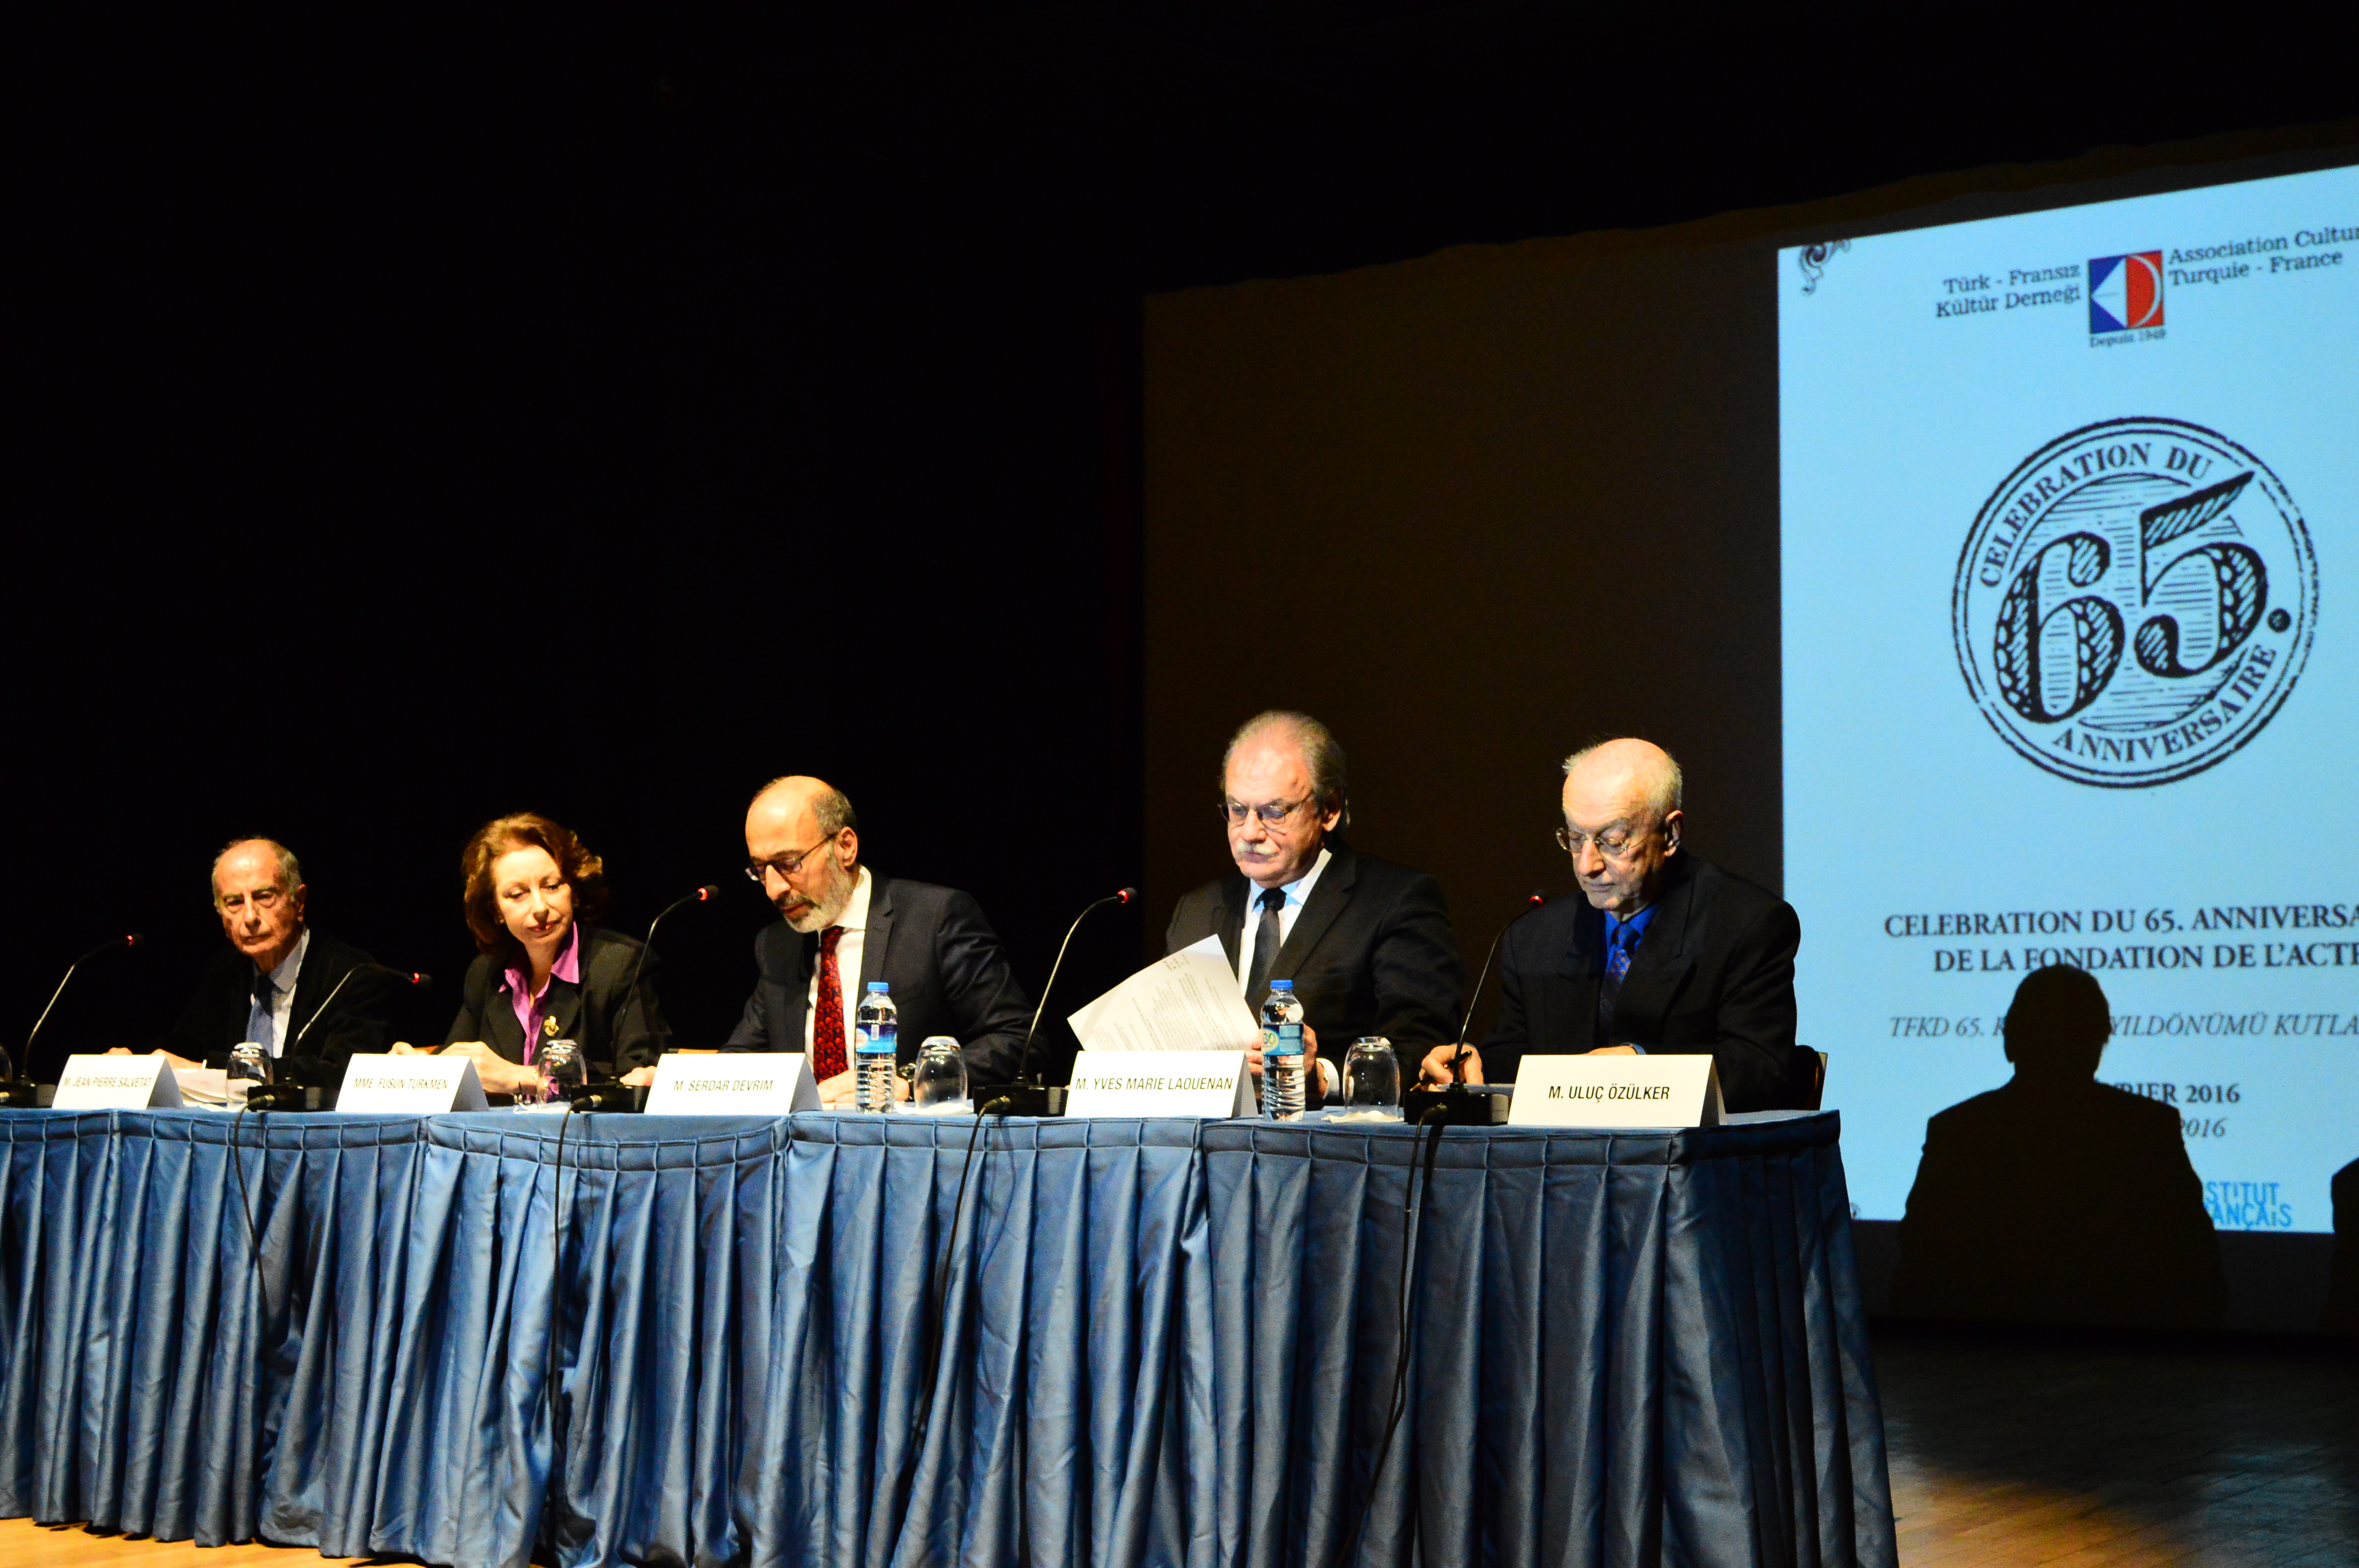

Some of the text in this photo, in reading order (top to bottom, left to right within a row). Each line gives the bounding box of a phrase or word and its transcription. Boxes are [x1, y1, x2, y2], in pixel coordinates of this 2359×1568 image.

[2169, 236, 2288, 265] Association
[1943, 274, 1990, 294] Türk
[2008, 264, 2080, 286] Fransız
[2169, 261, 2250, 286] Turquie
[2270, 251, 2343, 273] France
[1936, 284, 2081, 318] Kültür Derneği
[1980, 443, 2213, 588] CELEBRATION DU
[2053, 643, 2276, 763] ANNIVERSAIRE
[1884, 910, 2082, 938] CELEBRATION
[2092, 909, 2136, 933] DU
[2145, 908, 2183, 934] 65.
[1934, 948, 1974, 972] DE
[1980, 949, 2016, 972] LA
[2024, 944, 2203, 971] FONDATION
[2214, 944, 2257, 967] DE
[1890, 1016, 1950, 1037] TFKD
[1955, 1016, 1984, 1037] 65.
[2110, 1012, 2268, 1036] YILDÖNÜMÜ
[72, 1077, 91, 1087] JEAN
[91, 1077, 118, 1087] PIERRE
[118, 1077, 152, 1088] SALVETAT
[353, 1078, 375, 1089] MME.
[673, 1080, 773, 1091] M. SERDAR DEVRIM
[1075, 1077, 1233, 1090] M. YVES MARIE LAOUENAN
[1549, 1083, 1670, 1103] M. ULUÇ ÖZÜLKER
[2185, 1083, 2240, 1104] 2016
